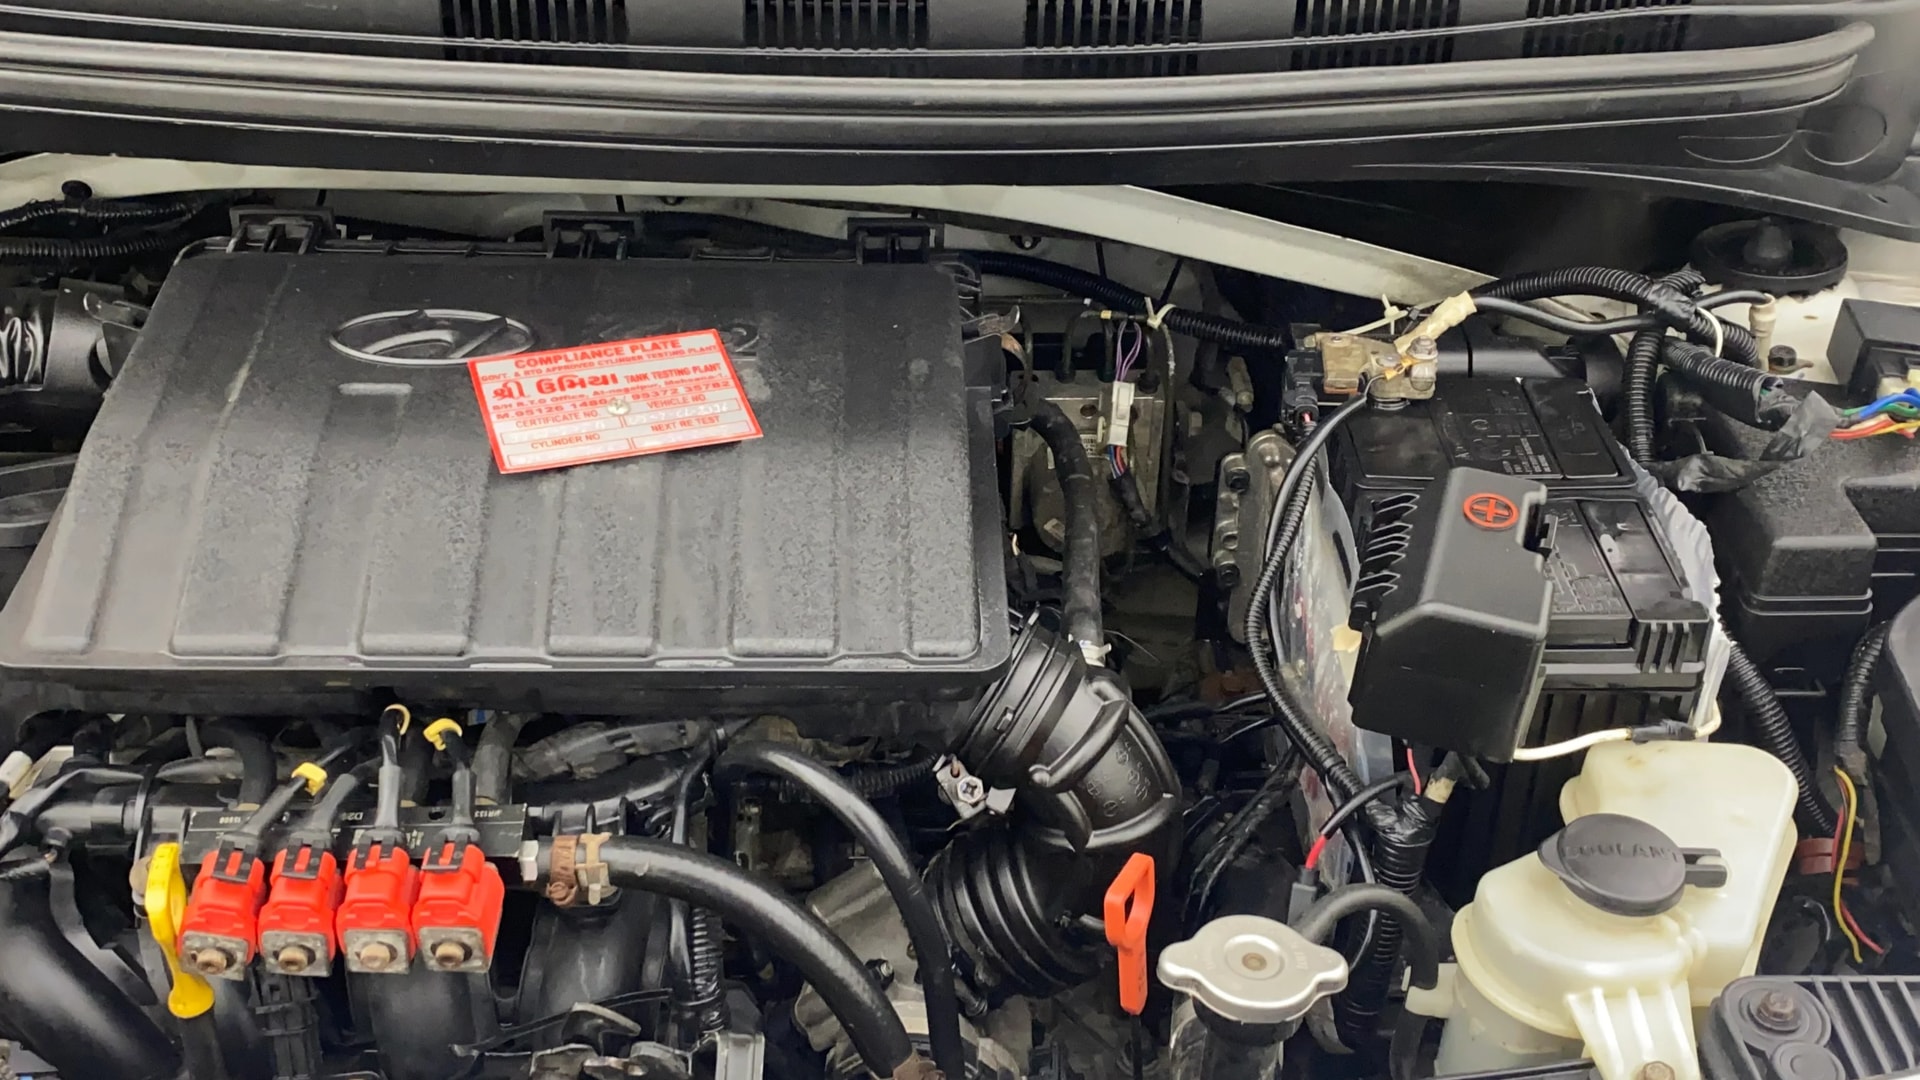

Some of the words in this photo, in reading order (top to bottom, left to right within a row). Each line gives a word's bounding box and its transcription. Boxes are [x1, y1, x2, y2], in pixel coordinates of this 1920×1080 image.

[514, 346, 625, 368] COMPLIANCE
[629, 339, 681, 353] PLATE
[522, 368, 543, 376] RTO
[545, 362, 595, 372] APPROVED
[597, 355, 643, 365] CYLINDER
[646, 350, 686, 358] TESTING
[687, 345, 717, 353] PLANT
[624, 373, 649, 383] TANK
[651, 367, 691, 379] TESTING
[692, 363, 722, 373] PLANT
[646, 396, 689, 408] VEHICLE
[515, 412, 582, 427] CERTIFICATE
[651, 422, 677, 431] NEXT
[678, 419, 695, 428] RE
[696, 415, 721, 424] TEST
[530, 436, 583, 448] CYLINDER
